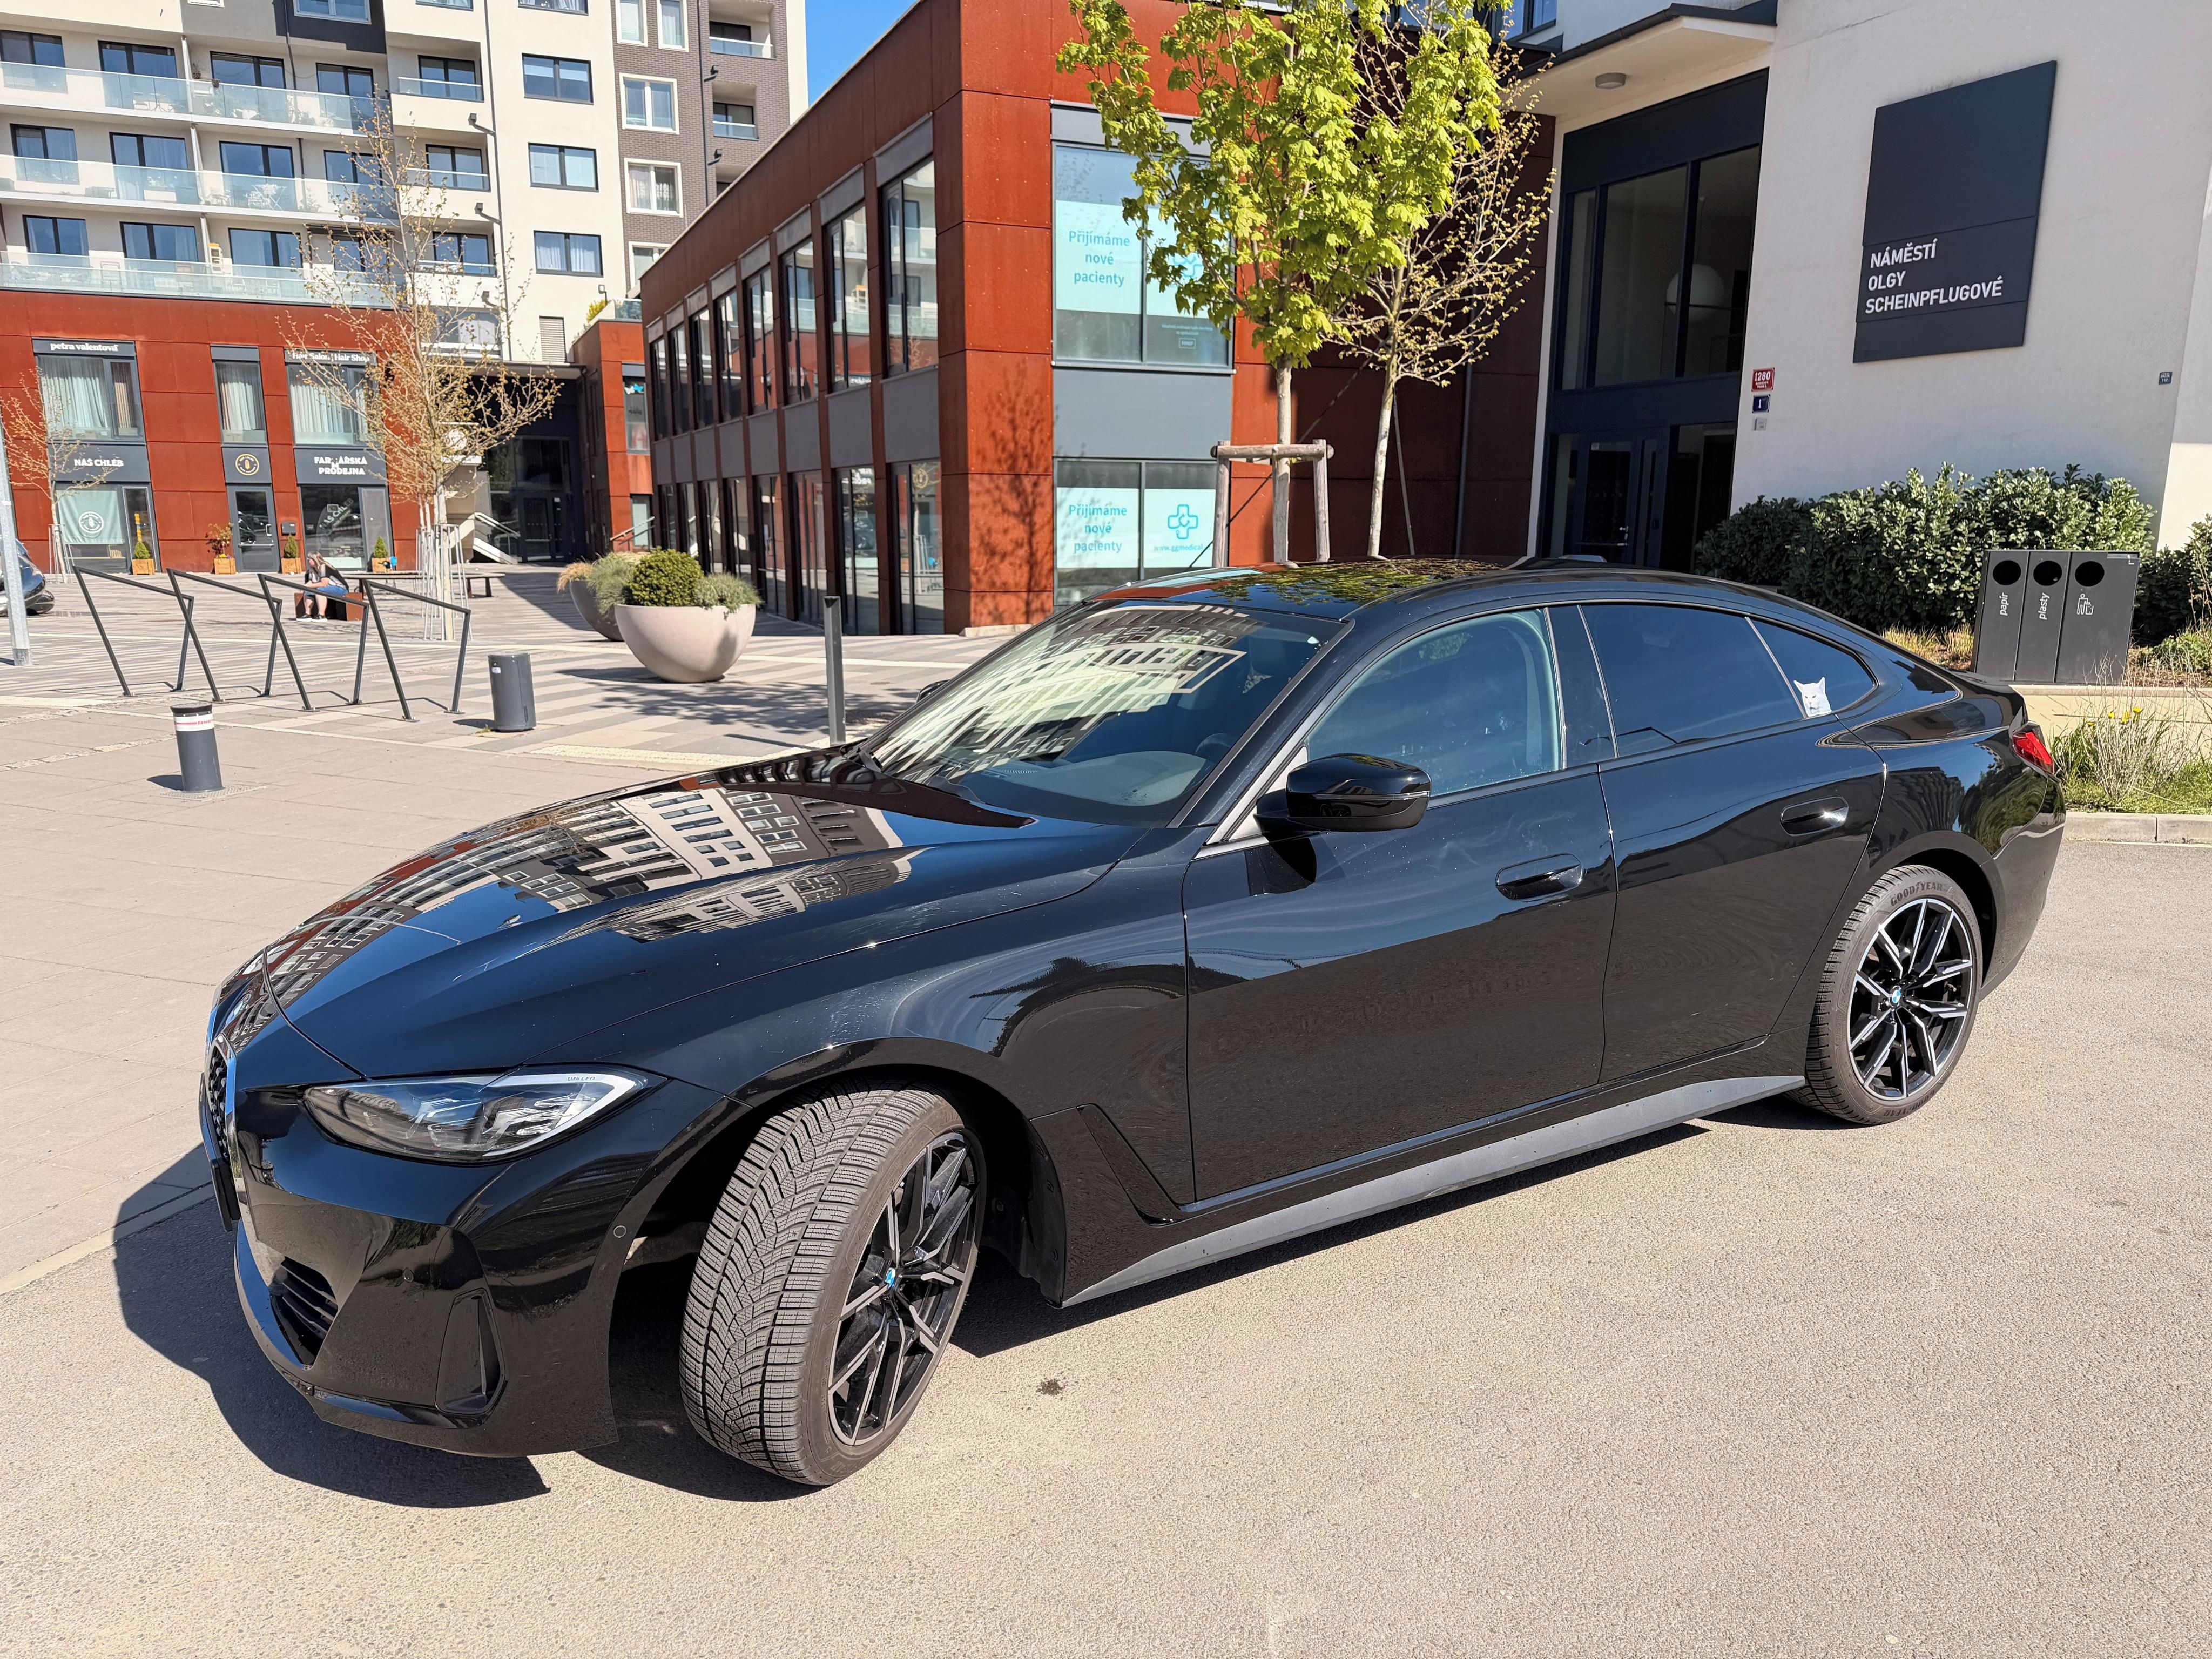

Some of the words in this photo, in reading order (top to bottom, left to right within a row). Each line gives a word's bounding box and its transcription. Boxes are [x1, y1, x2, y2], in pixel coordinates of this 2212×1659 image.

[1069, 230, 1130, 247] Přijímáme
[1085, 251, 1114, 265] nové
[1870, 238, 1938, 268] NÁMĚSTÍ
[1074, 271, 1124, 288] pacienty
[1867, 271, 1906, 291] OLGY
[1865, 275, 2004, 314] SCHEINPFLUGOVÉ
[50, 342, 76, 351] petra
[75, 342, 119, 352] valentová
[334, 353, 350, 361] Hair
[351, 354, 370, 363] Shop
[1754, 370, 1771, 382] 1280
[1758, 398, 1762, 409] 1
[318, 467, 366, 475] PRODEJNA
[1069, 503, 1128, 518] Přijímáme
[1084, 521, 1112, 534] nové
[1074, 541, 1123, 554] pacienty
[1999, 592, 2009, 616] papír
[2038, 592, 2051, 621] plasty
[1890, 881, 1943, 906] GOODYEAR
